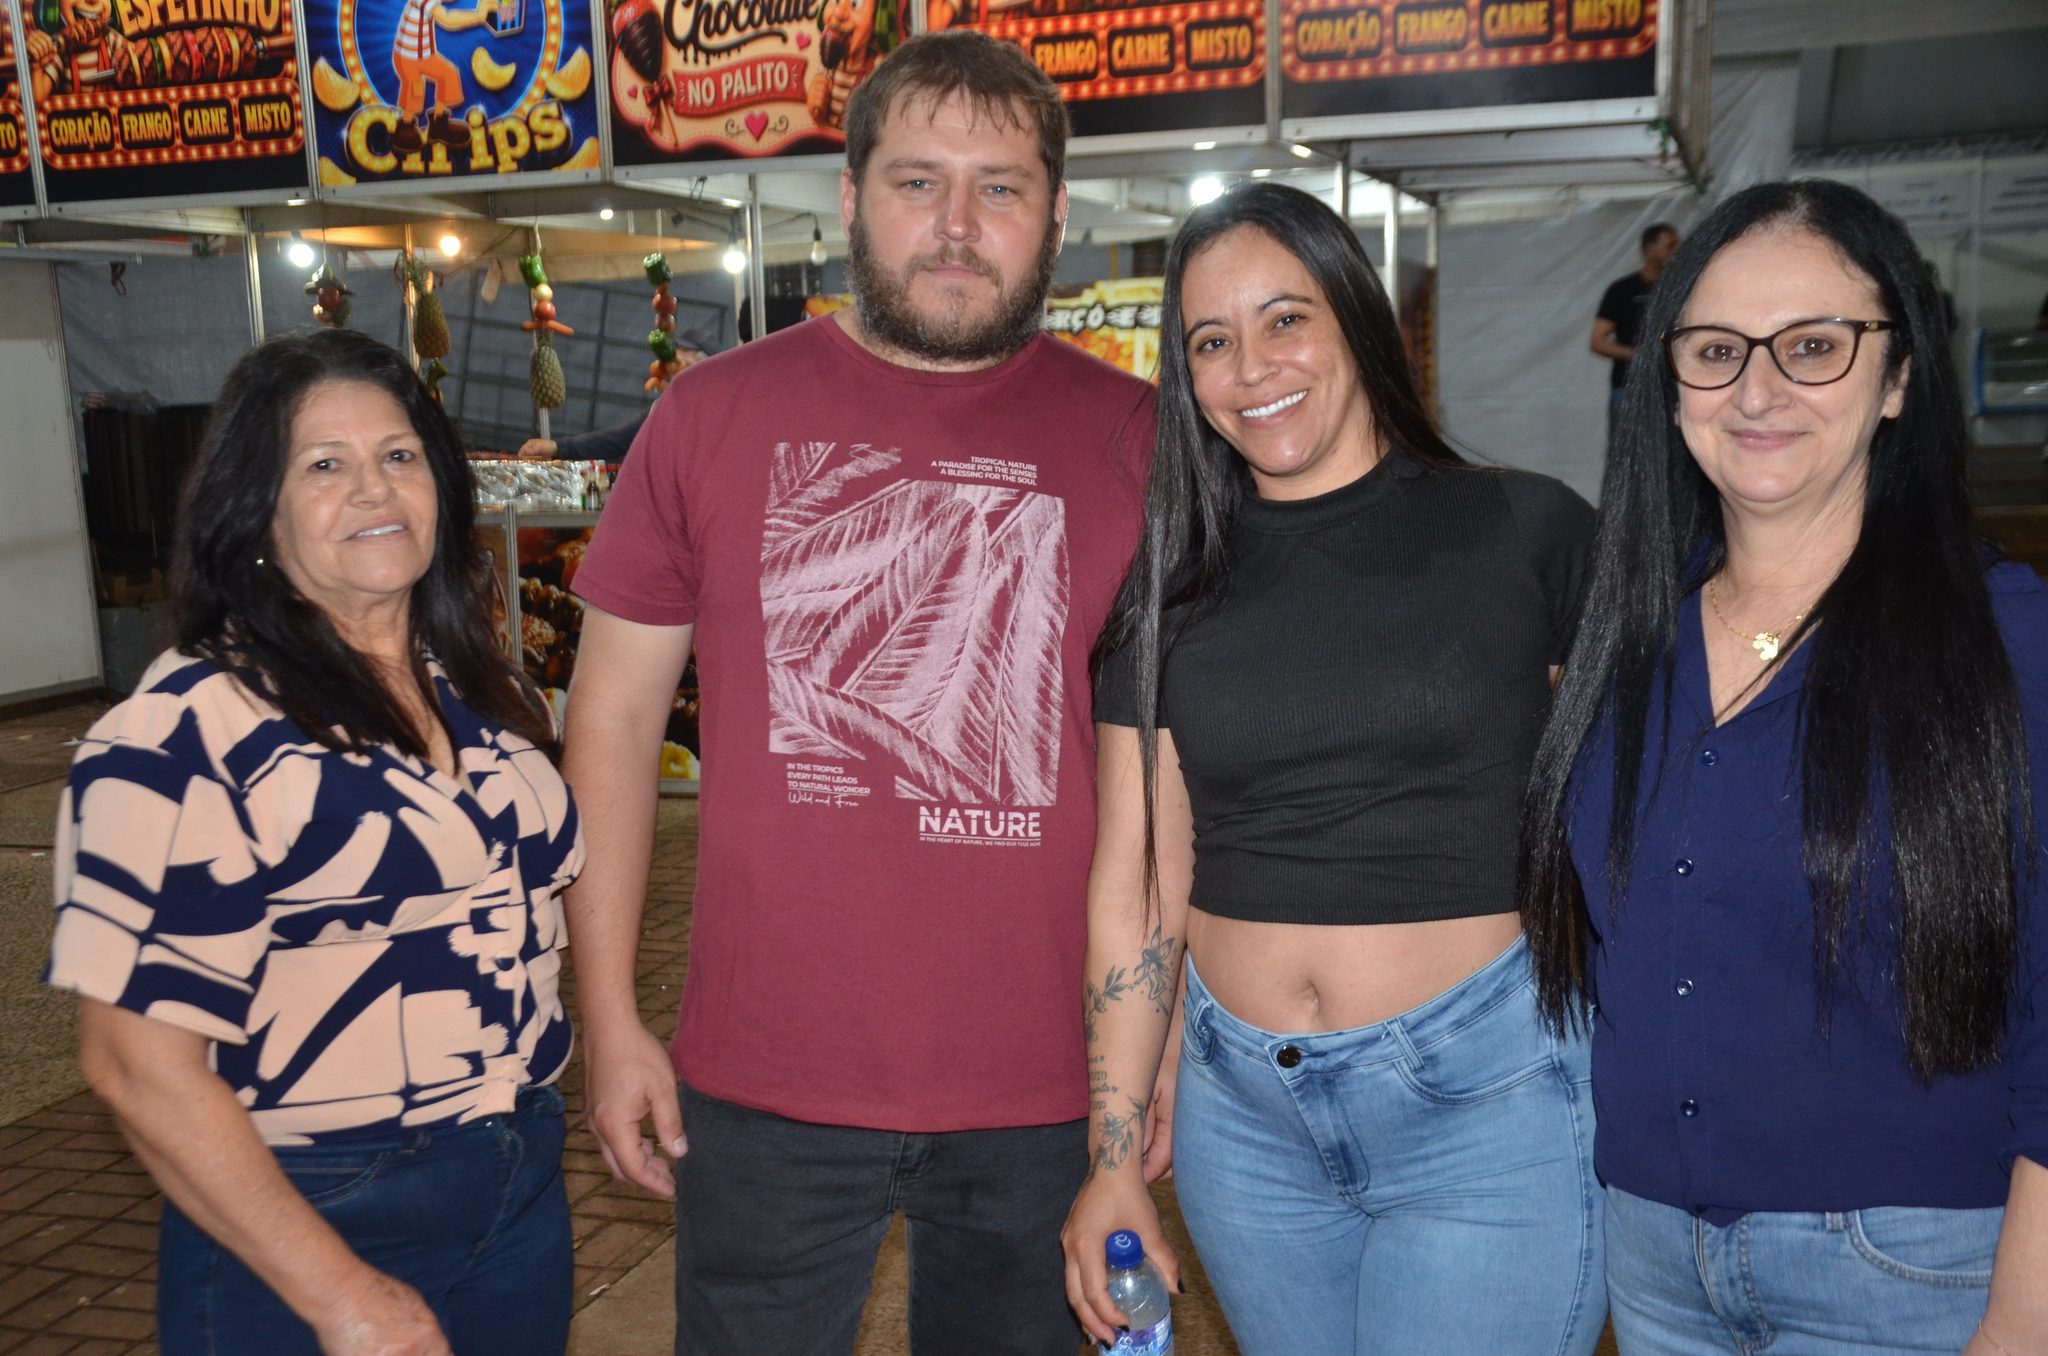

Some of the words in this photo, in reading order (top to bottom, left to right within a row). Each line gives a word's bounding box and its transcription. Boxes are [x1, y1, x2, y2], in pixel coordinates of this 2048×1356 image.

[1298, 10, 1381, 58] CORAÇÃO
[1397, 8, 1468, 45] FRANGO
[1483, 2, 1549, 39] CARNE
[1571, 0, 1642, 32] MISTO
[1035, 39, 1097, 76] FRANGO
[1111, 32, 1170, 71] CARNE
[1191, 24, 1251, 63] MISTO
[688, 81, 716, 107] NO
[721, 62, 789, 100] PALITO
[51, 115, 111, 150] CORAÇÃO
[121, 110, 172, 142] FRANGO
[184, 106, 229, 137] CARNE
[244, 101, 291, 133] MISTO
[938, 461, 976, 471] PARADISE
[977, 464, 993, 472] FOR
[993, 466, 1009, 474] THE
[1009, 467, 1037, 479] SENSES
[971, 456, 1006, 467] TROPICAL
[1008, 461, 1037, 472] NATURE
[947, 469, 984, 479] BLESSING
[984, 472, 1001, 480] FOR
[1001, 474, 1017, 482] THE
[1017, 475, 1037, 486] SOUL
[796, 763, 812, 771] THE
[812, 765, 844, 774] TROPICS
[799, 782, 833, 791] NATURAL
[833, 785, 871, 794] WONDER
[812, 774, 831, 782] PATH
[832, 775, 858, 784] LEADS
[920, 806, 1041, 837] NATURE
